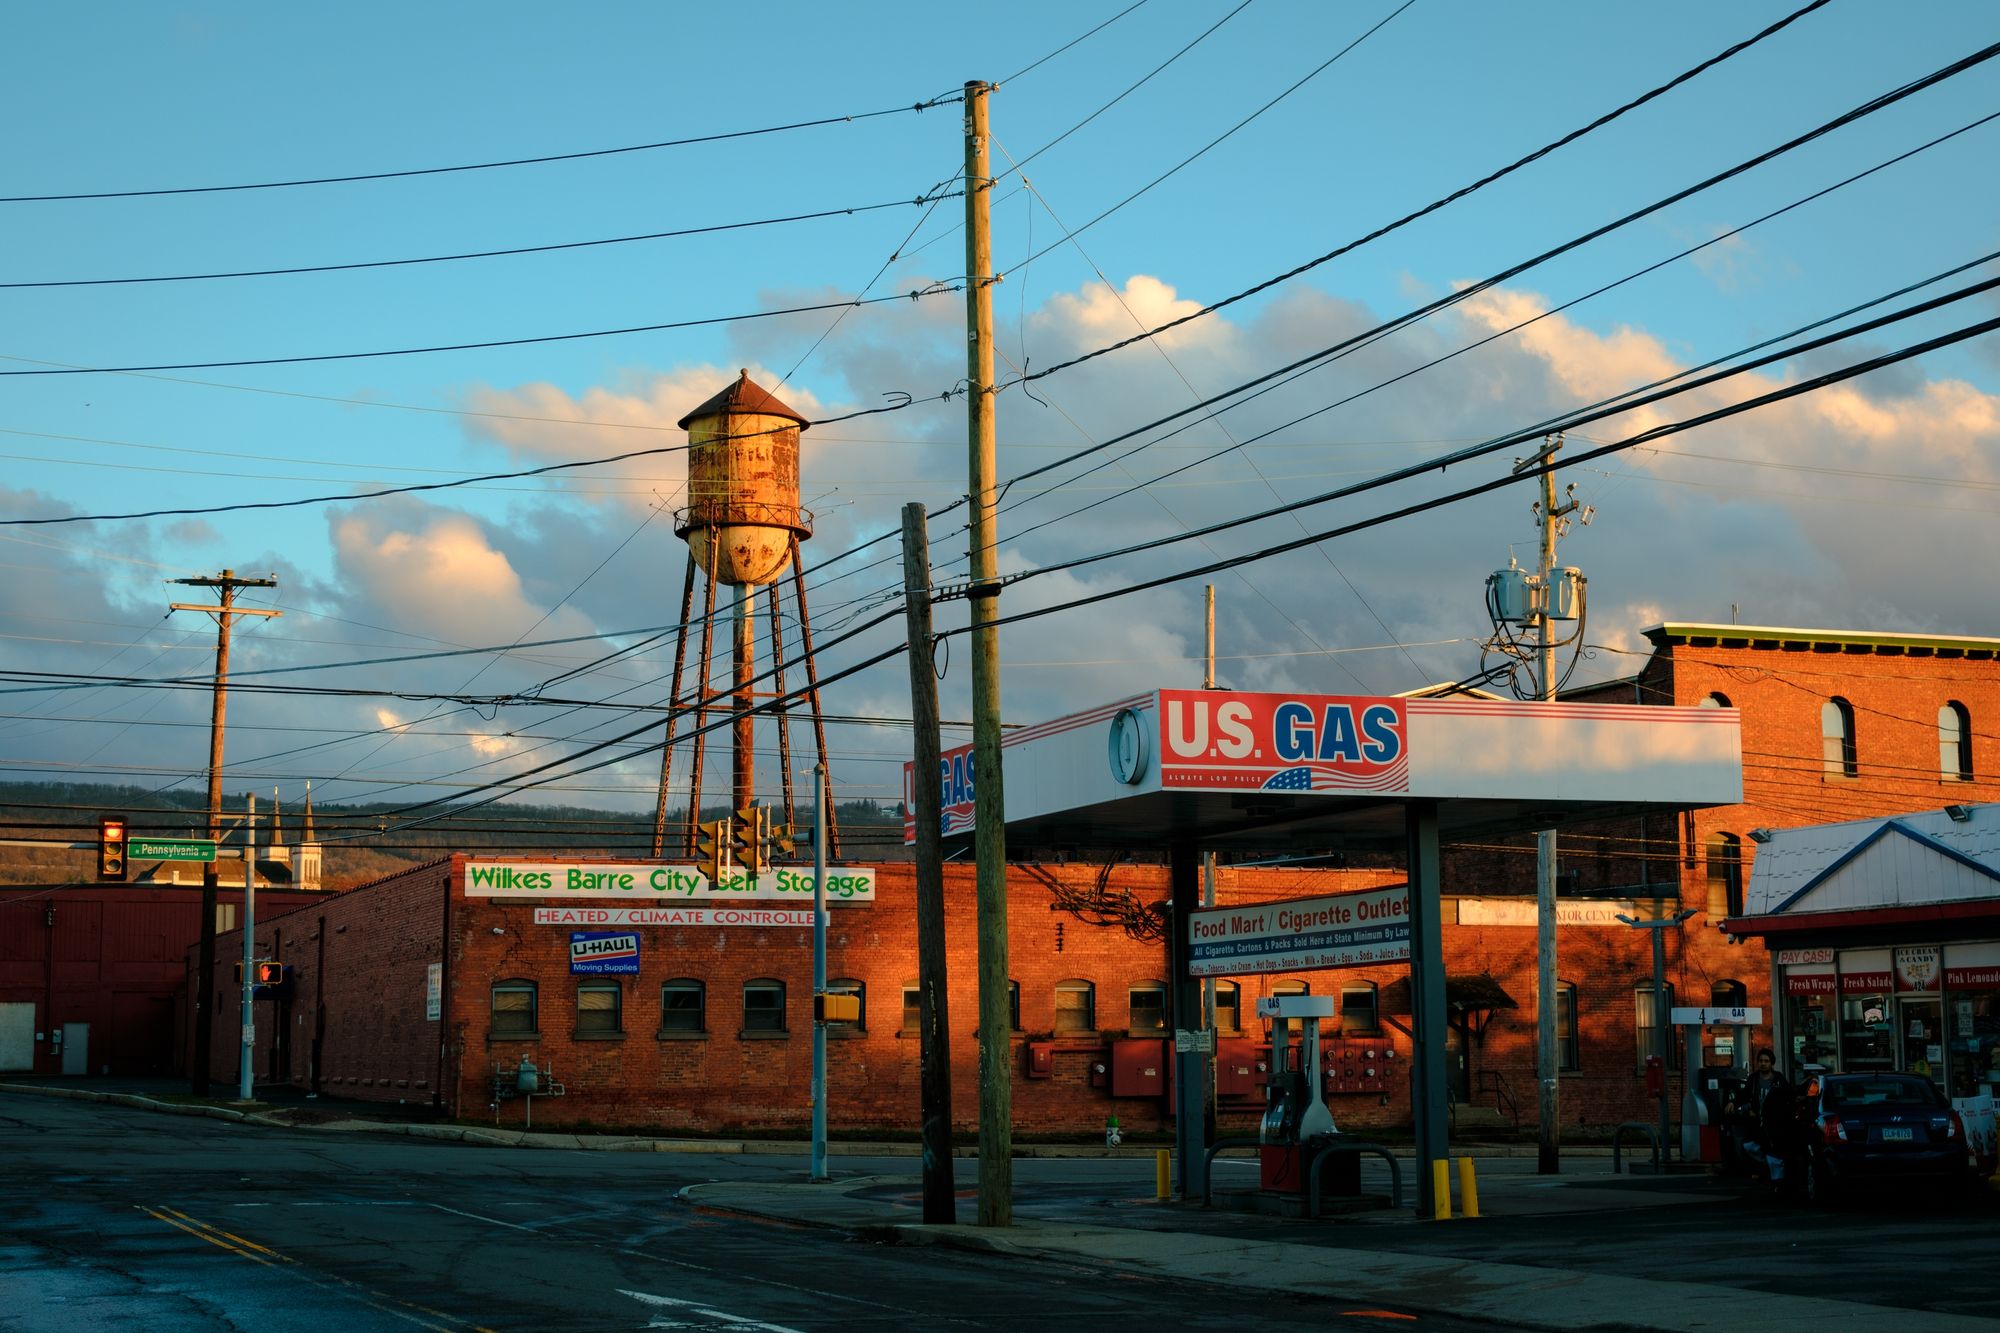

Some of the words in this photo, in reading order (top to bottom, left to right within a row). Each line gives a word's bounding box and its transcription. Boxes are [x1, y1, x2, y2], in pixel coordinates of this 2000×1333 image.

[1168, 700, 1262, 759] U.S.
[1272, 700, 1402, 765] GAS
[141, 844, 199, 858] Pennsylvania
[471, 866, 552, 890] Wilkes
[567, 869, 635, 891] Barre
[649, 869, 700, 896] City
[776, 870, 871, 897] Stoage
[537, 910, 609, 922] HEATED
[628, 911, 704, 923] CLIMATE
[713, 911, 815, 924] CONTROLLE
[1194, 918, 1226, 938] Food
[1231, 915, 1265, 934] Mart
[1278, 905, 1351, 932] Cigarette
[1357, 895, 1409, 921] Outlet
[573, 938, 634, 955] U-HAUL
[1194, 947, 1203, 956] All
[1205, 945, 1235, 957] Cigarette
[1237, 942, 1263, 953] Cartons
[1270, 939, 1291, 949] Packs
[1294, 937, 1308, 947] Sold
[1309, 936, 1325, 946] Here
[1326, 936, 1332, 945] at
[1334, 934, 1352, 943] State
[1354, 931, 1383, 942] Minimum
[1385, 928, 1394, 940] By
[1395, 927, 1410, 937] Law
[1208, 964, 1225, 974] Tobacco
[1238, 962, 1251, 971] Cream
[1282, 958, 1299, 967] Snacks
[1321, 954, 1336, 964] Bread
[1359, 950, 1373, 961] Soda
[1379, 949, 1394, 959] Juice
[1399, 947, 1410, 957] Wat
[1781, 951, 1800, 963] PAY
[1802, 950, 1832, 962] CASH
[1906, 955, 1934, 963] CANDY
[573, 964, 603, 972] Moving
[604, 964, 638, 972] Supplies
[1843, 977, 1865, 989] Fresh
[1948, 972, 1965, 984] Pink
[1967, 970, 2000, 984] Lemonad
[1789, 979, 1809, 990] Fresh
[1811, 979, 1835, 992] Wraps
[1699, 1008, 1705, 1024] 4
[1732, 1008, 1746, 1017] GAS
